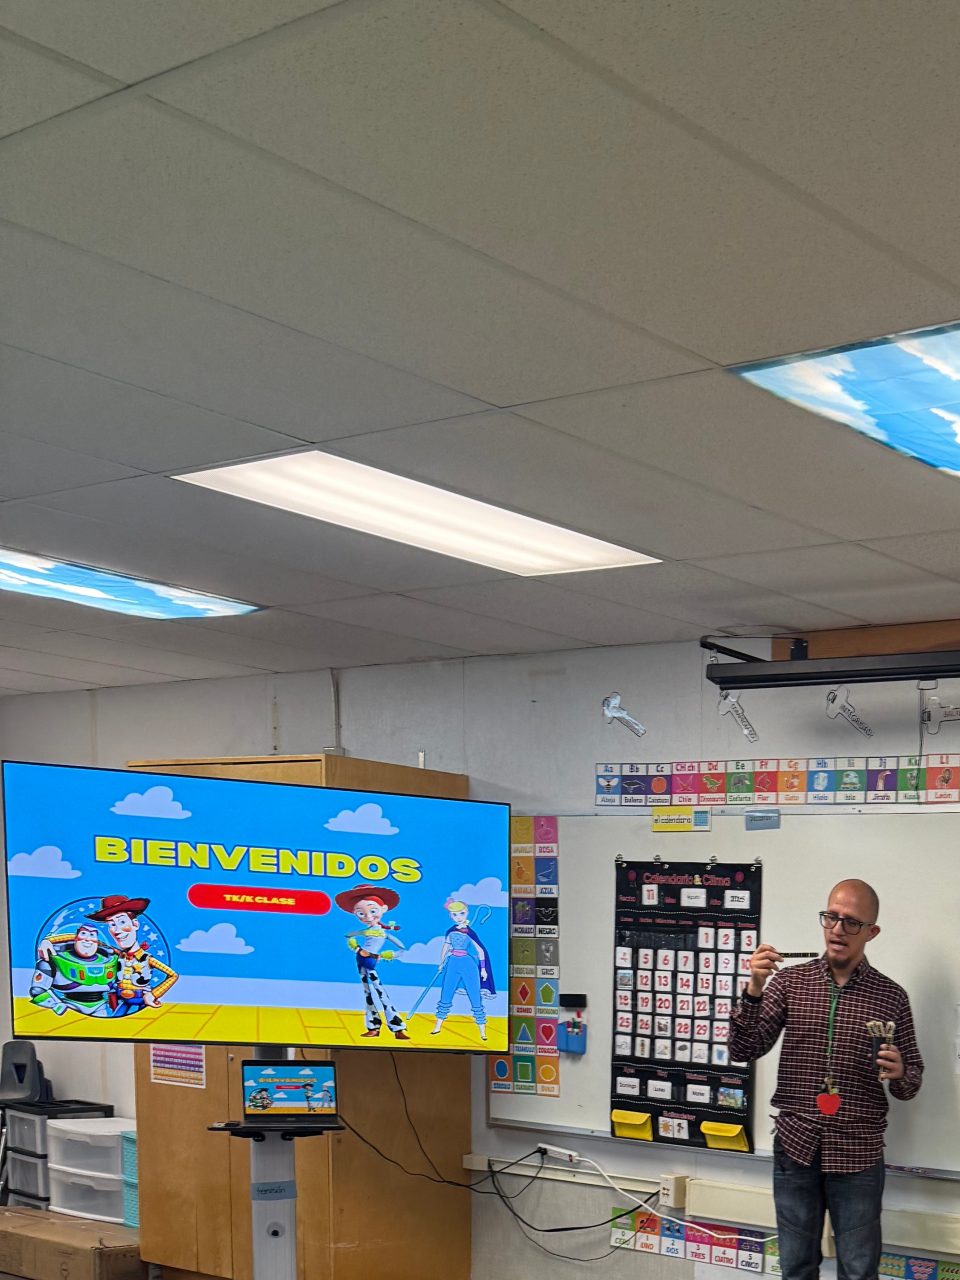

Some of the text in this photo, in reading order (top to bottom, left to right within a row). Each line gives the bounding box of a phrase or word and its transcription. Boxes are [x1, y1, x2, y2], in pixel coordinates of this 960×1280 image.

[735, 761, 745, 770] Ee
[94, 836, 422, 883] BIENVENIDOS
[223, 894, 296, 906] TK/K CLASE
[704, 932, 753, 946] 1 2 3
[642, 953, 650, 965] 5
[662, 955, 670, 966] 6
[682, 956, 689, 967] 7
[703, 957, 711, 968] 8
[640, 975, 650, 986] 12
[657, 975, 669, 987] 13
[679, 978, 690, 989] 14
[700, 978, 711, 990] 15
[718, 979, 729, 991] 16
[619, 995, 729, 1014] 18 19 20 21 22 23
[619, 1016, 631, 1028] 25
[639, 1018, 650, 1030] 26
[677, 1022, 690, 1034] 28
[696, 1024, 708, 1036] 29
[640, 1242, 654, 1250] UNO
[670, 1239, 676, 1247] 2
[666, 1246, 679, 1255] DOS
[690, 1251, 706, 1260] TRES
[740, 1259, 760, 1269] CINCO
